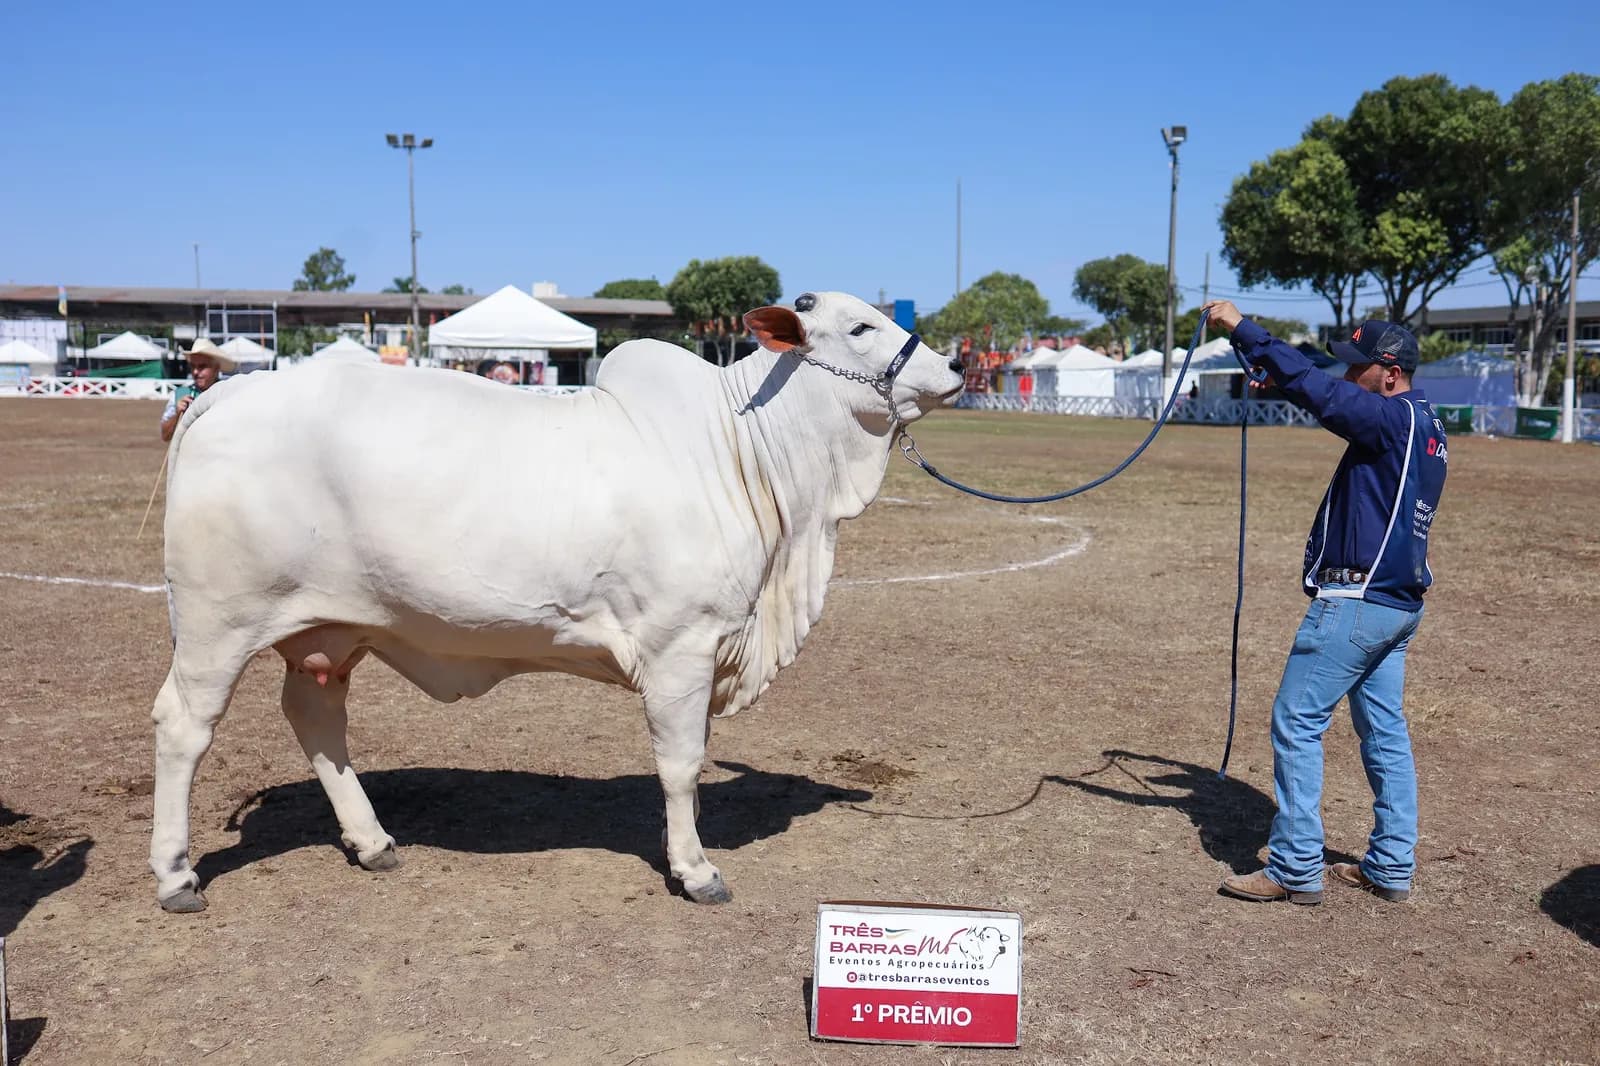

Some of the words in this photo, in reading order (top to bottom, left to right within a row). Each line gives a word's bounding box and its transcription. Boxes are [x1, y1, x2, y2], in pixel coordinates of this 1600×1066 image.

[829, 922, 884, 938] TRÊS
[830, 941, 917, 956] BARRAS
[829, 956, 881, 966] Eventos
[887, 957, 985, 970] Agropecuários
[878, 1000, 973, 1027] PRÊMIO
